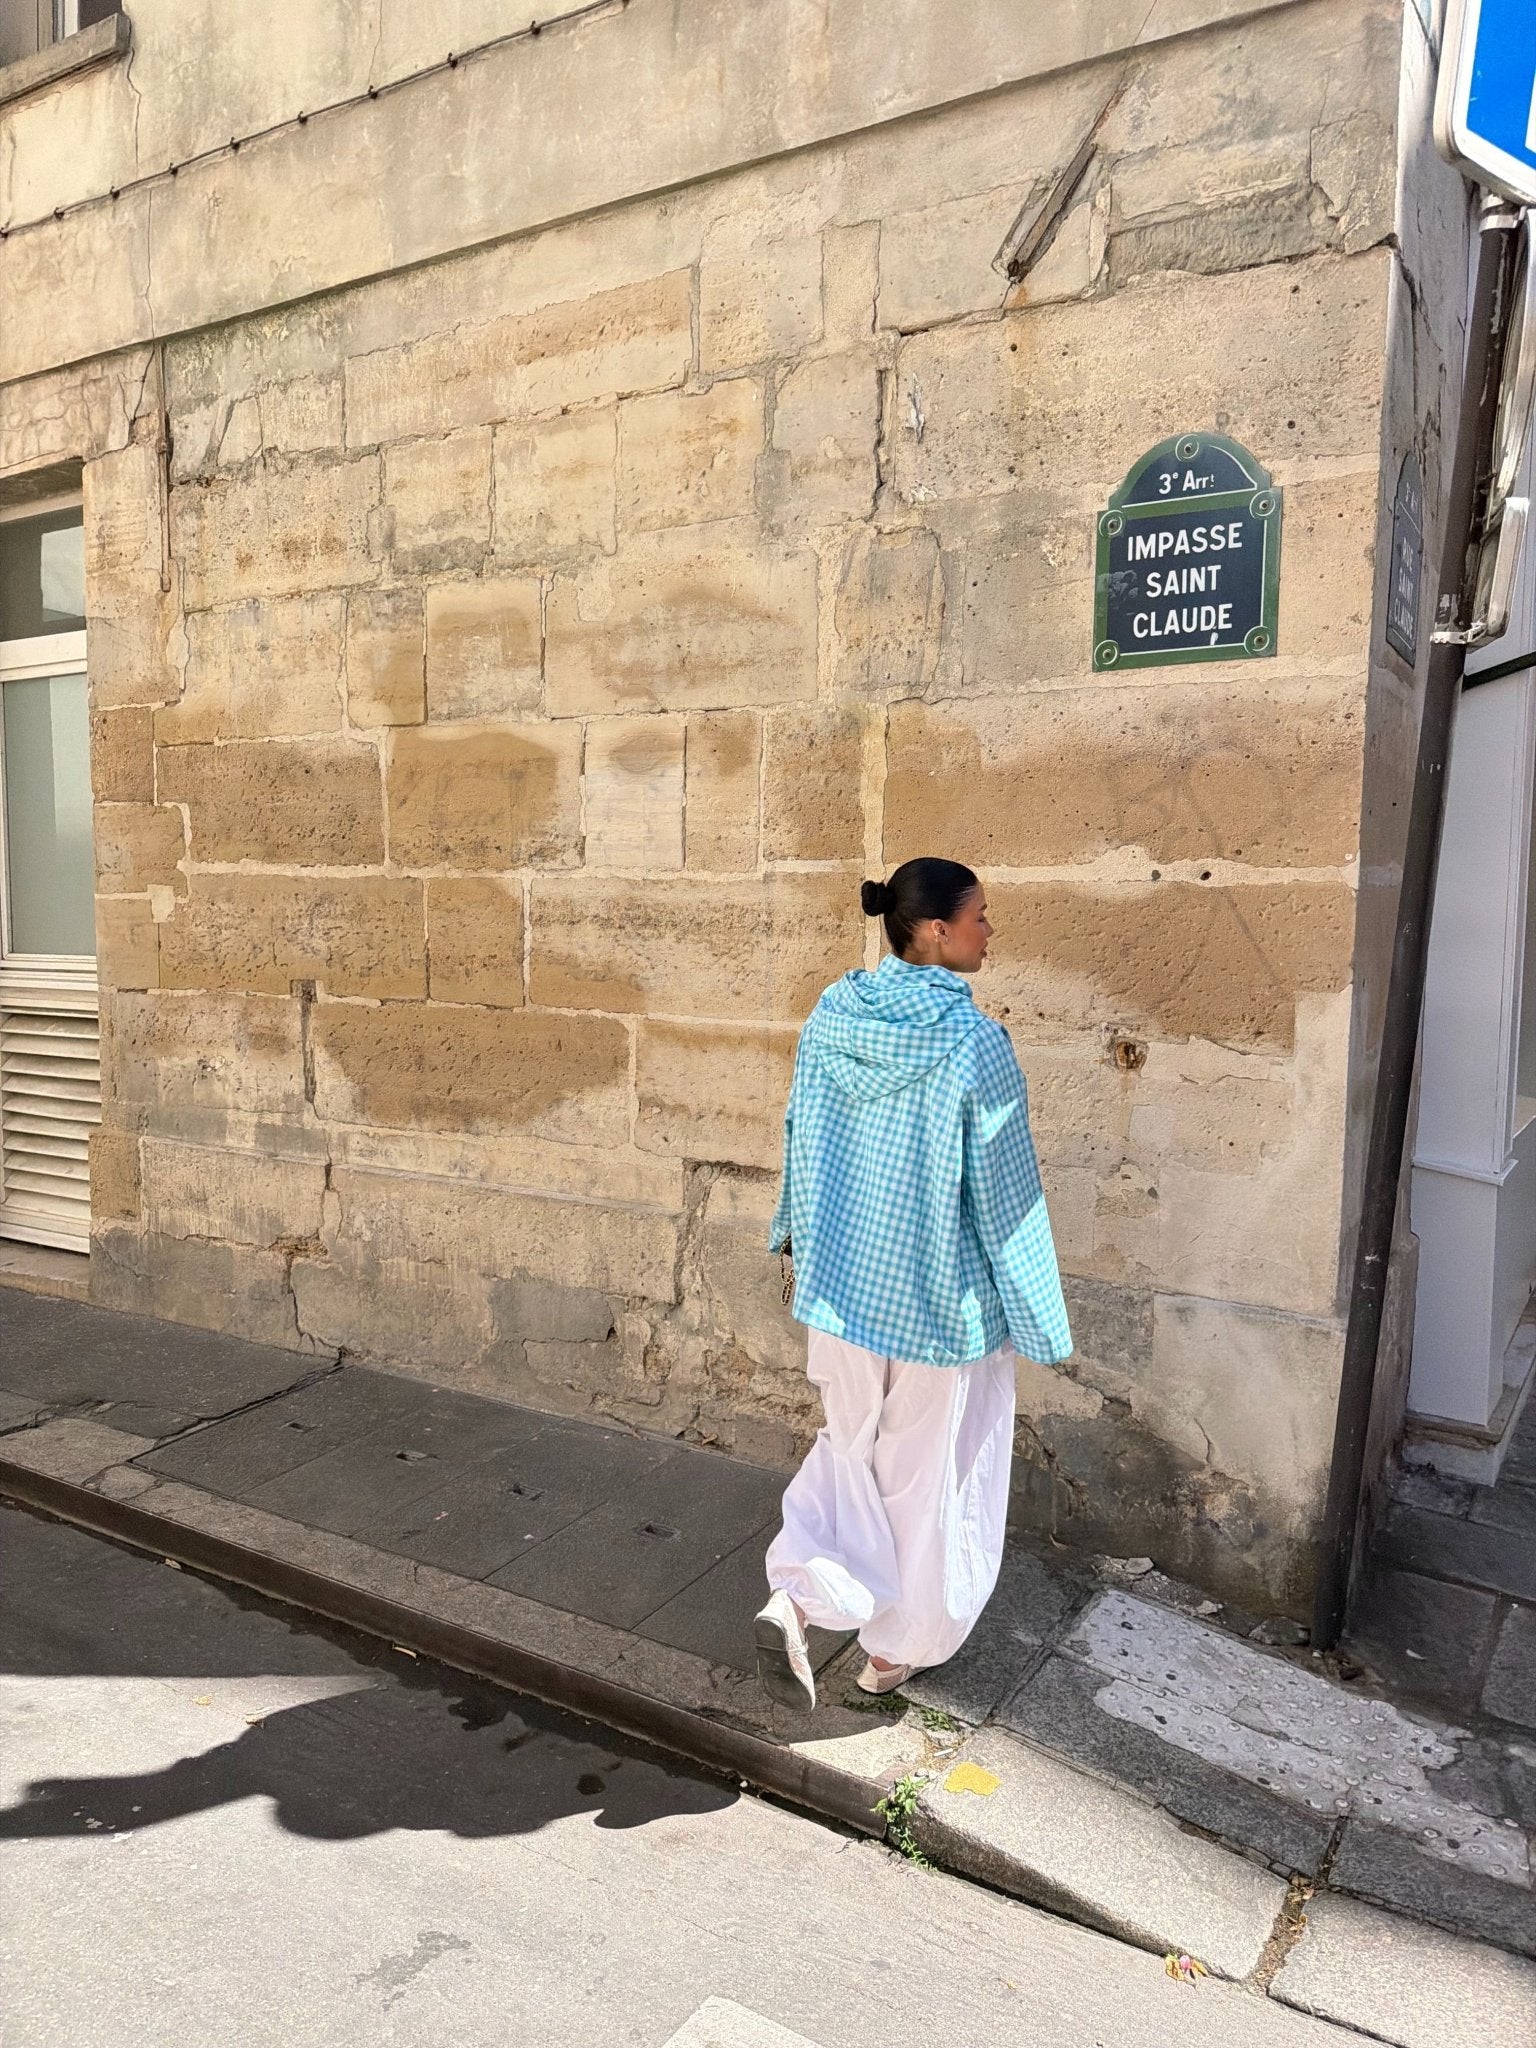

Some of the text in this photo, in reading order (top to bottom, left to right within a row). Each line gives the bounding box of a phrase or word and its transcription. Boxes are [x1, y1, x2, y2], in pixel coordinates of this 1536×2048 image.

[1127, 522, 1243, 561] IMPASSE
[1146, 564, 1221, 598] SAINT
[1133, 603, 1233, 638] CLAUDE
